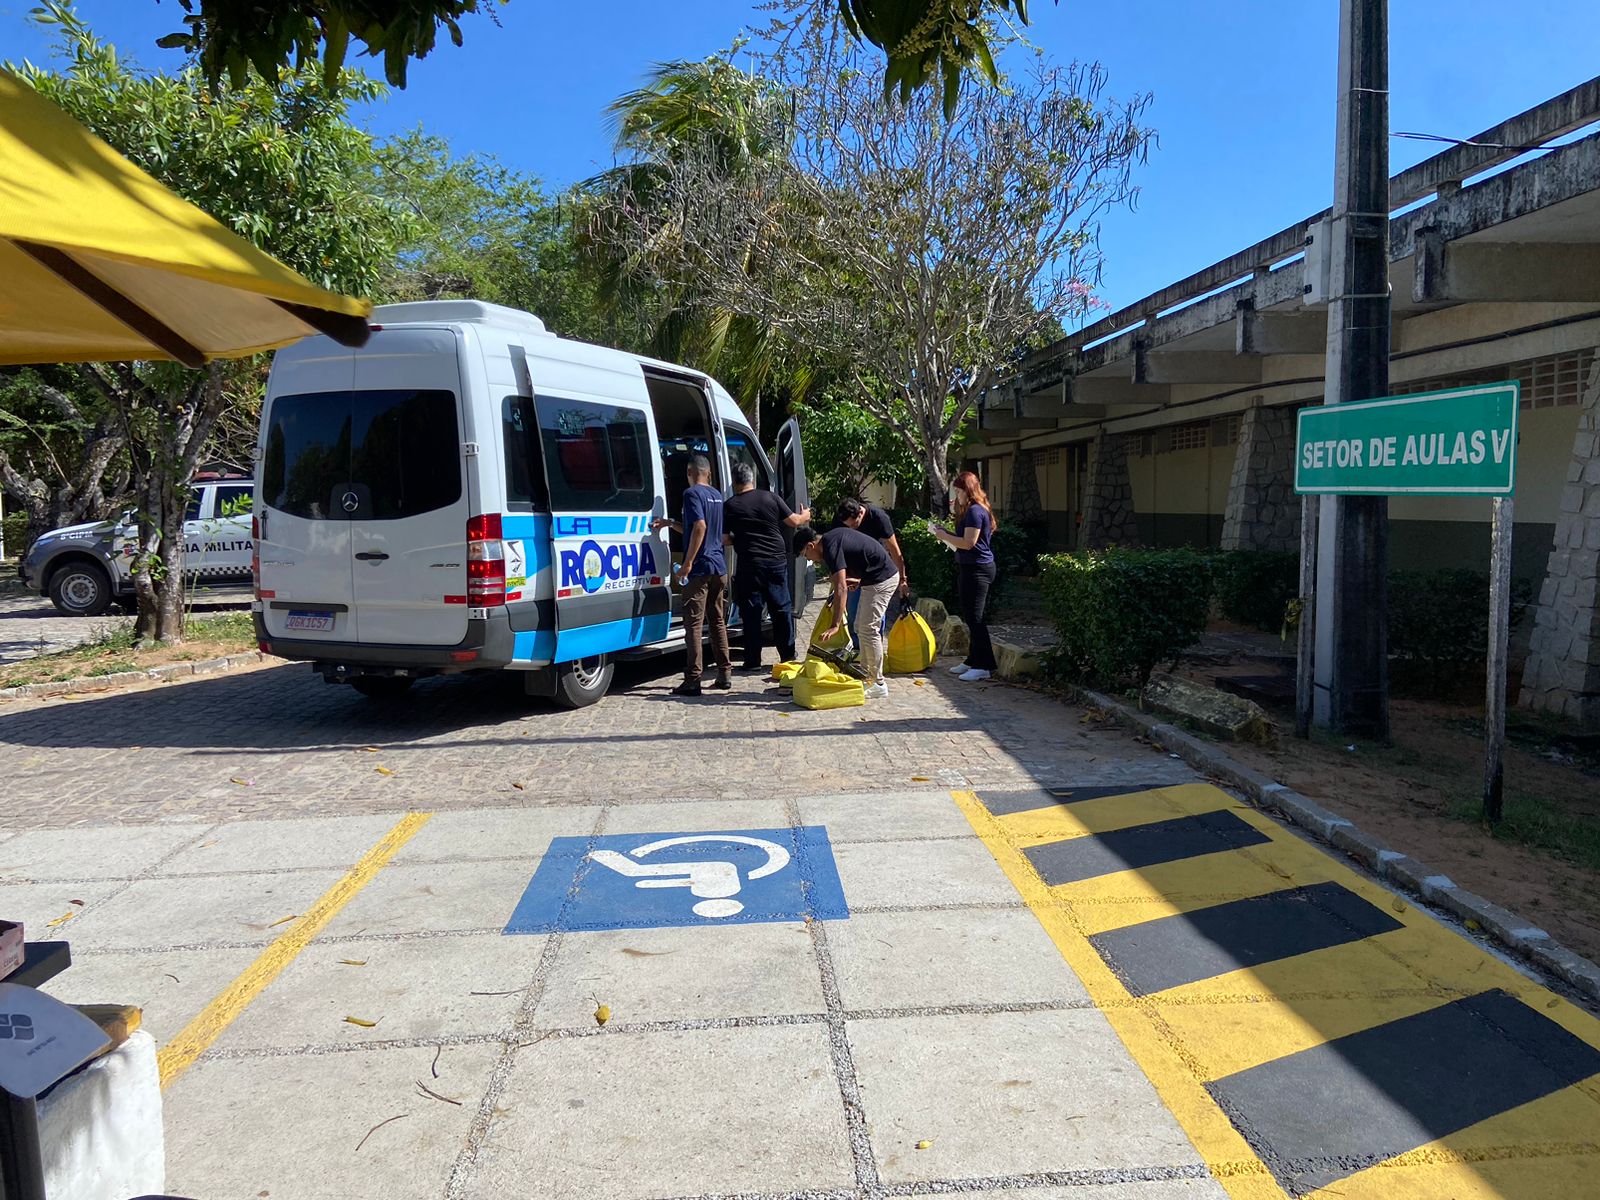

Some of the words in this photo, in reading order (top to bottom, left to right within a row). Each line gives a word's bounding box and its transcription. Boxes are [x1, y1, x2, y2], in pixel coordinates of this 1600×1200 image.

[1302, 439, 1363, 469] SETOR
[1369, 436, 1397, 467] DE
[1401, 430, 1486, 466] AULAS
[1491, 429, 1510, 463] V
[557, 517, 592, 535] LA
[205, 541, 253, 552] MILITA
[560, 539, 657, 594] ROCHA
[605, 577, 651, 591] RECEPTIV
